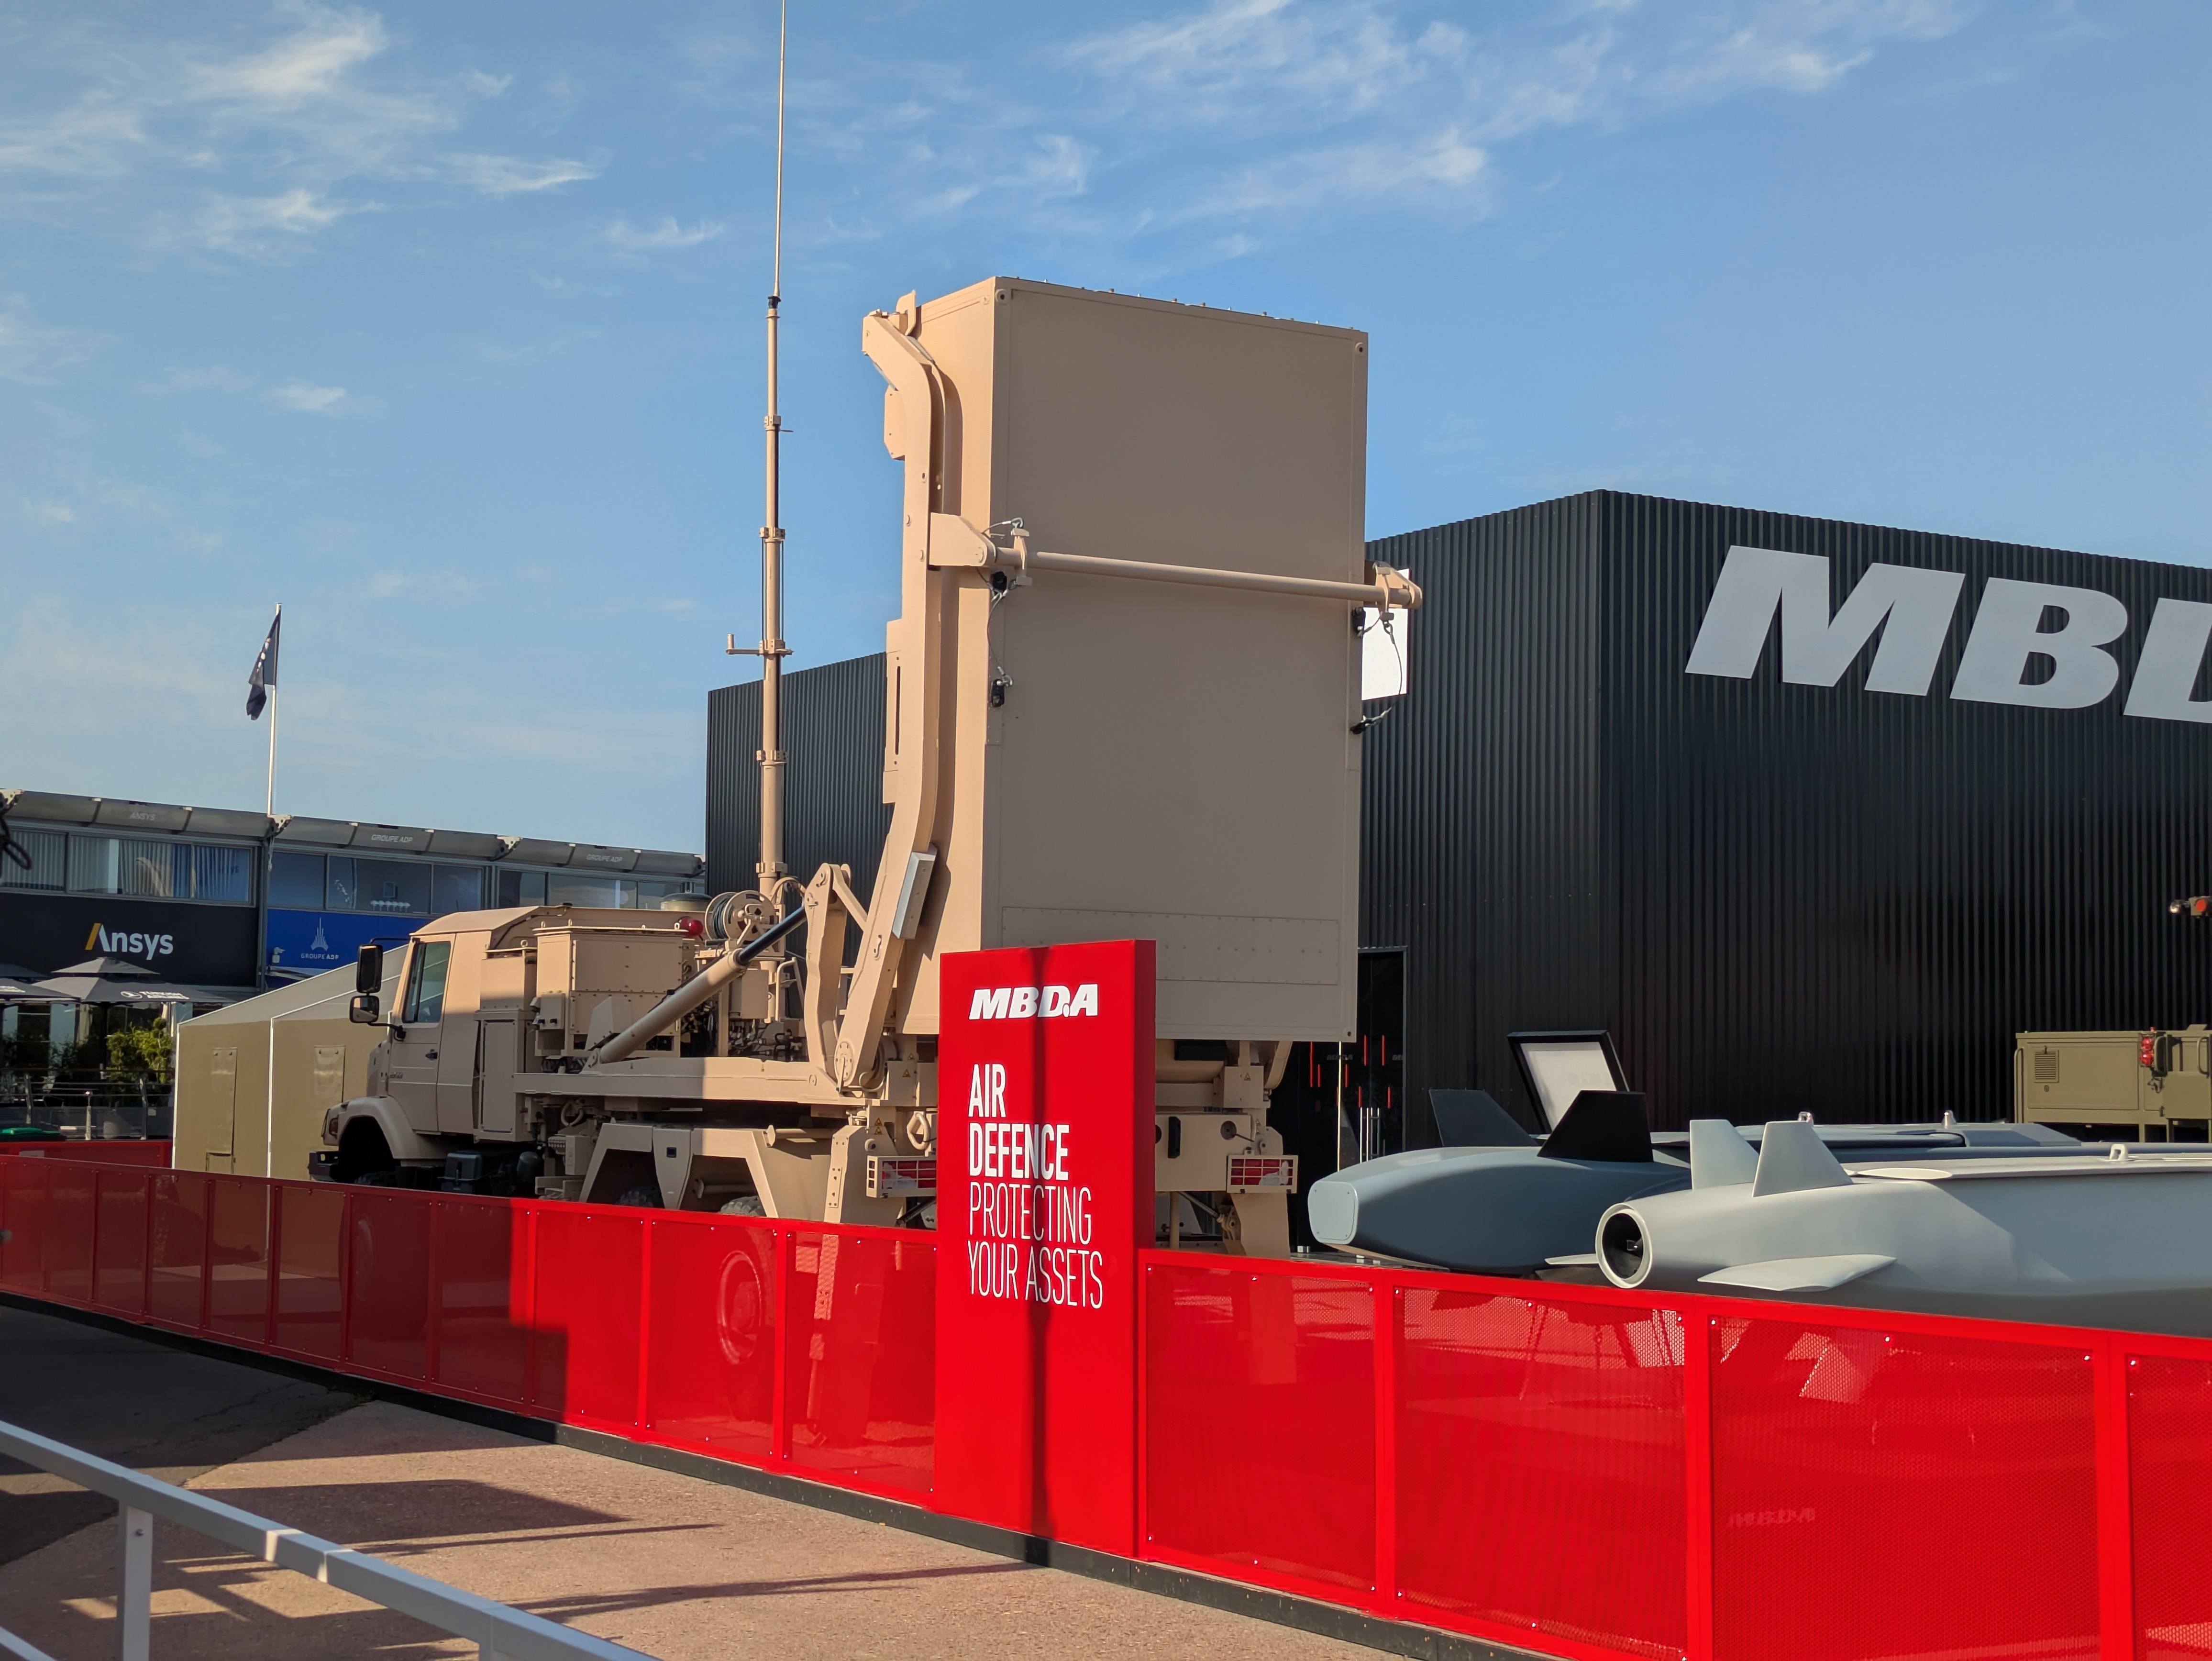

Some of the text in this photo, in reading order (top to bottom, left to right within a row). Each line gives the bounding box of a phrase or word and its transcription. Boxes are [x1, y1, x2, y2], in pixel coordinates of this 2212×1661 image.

[129, 812, 155, 821] ANSYS
[85, 922, 174, 960] Ansys
[968, 1063, 1006, 1118] AIR
[969, 1123, 1070, 1181] DEFENCE
[969, 1182, 1092, 1245] PROTECTING
[967, 1240, 1103, 1309] YOUR ASSETS
